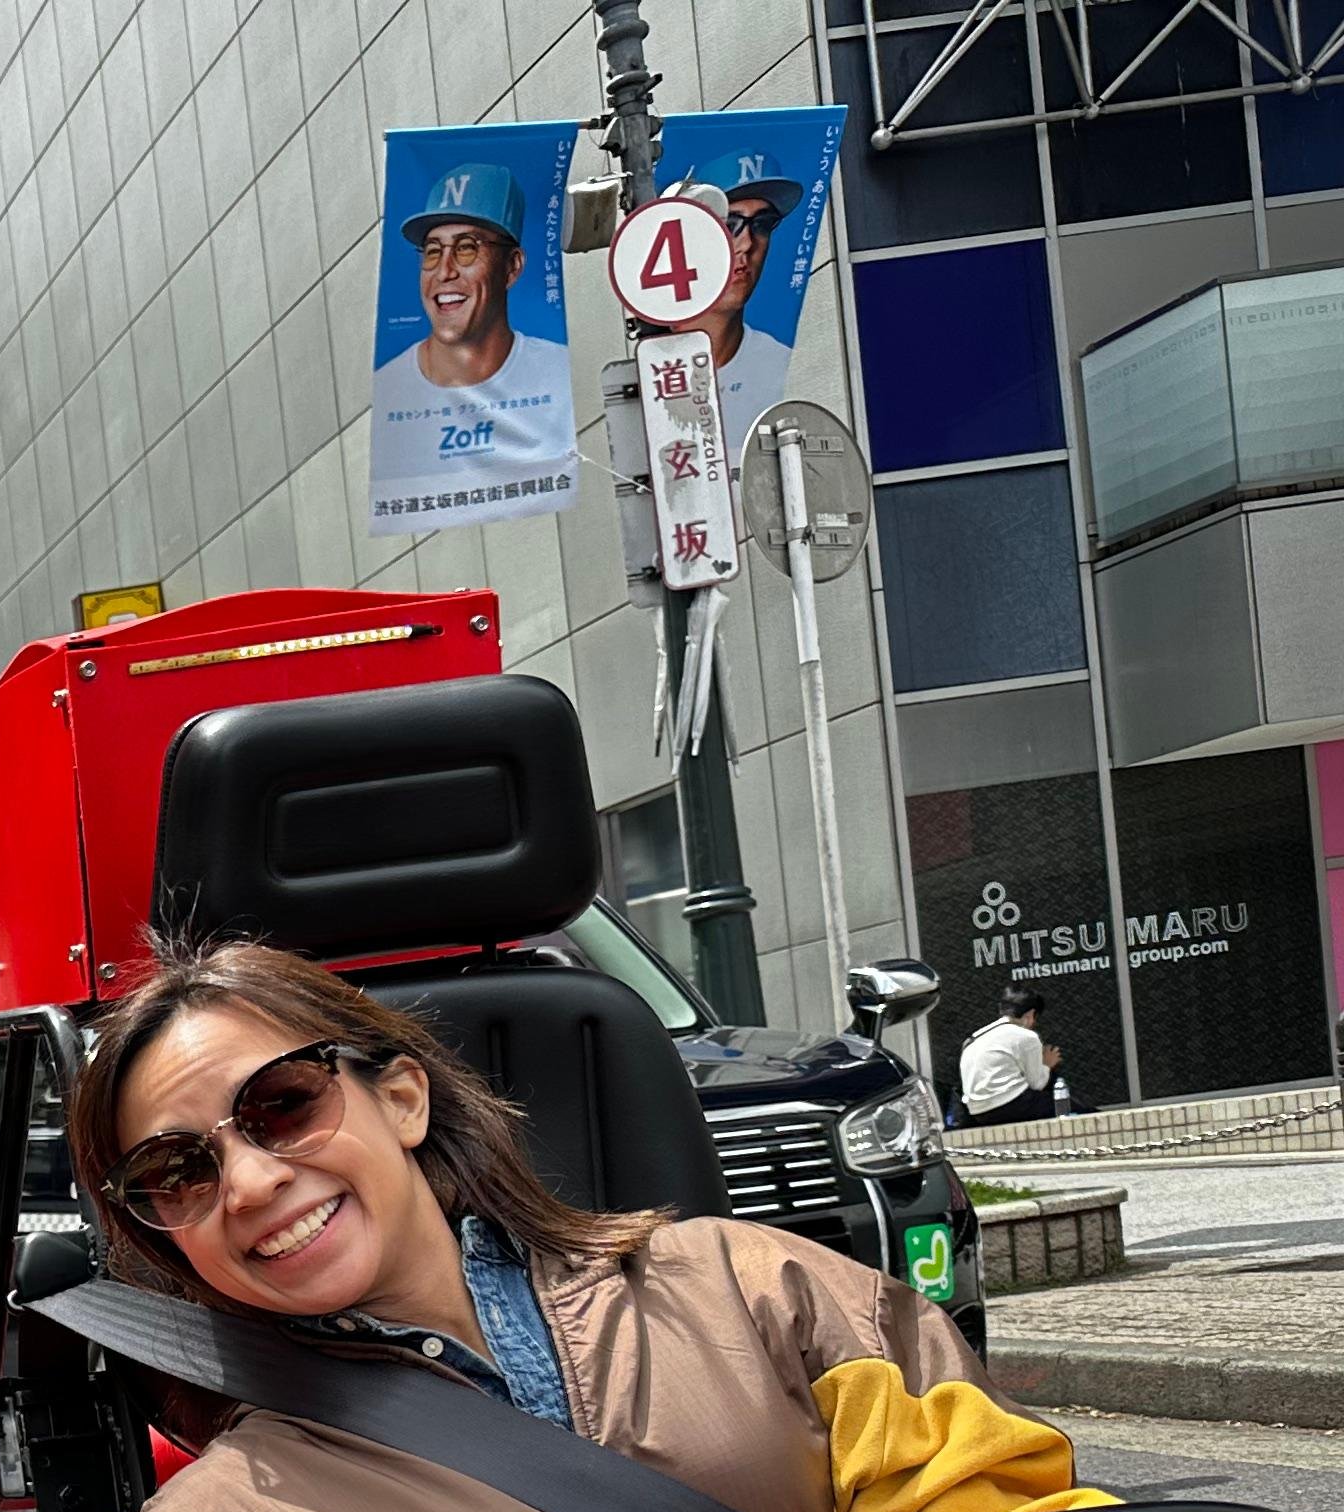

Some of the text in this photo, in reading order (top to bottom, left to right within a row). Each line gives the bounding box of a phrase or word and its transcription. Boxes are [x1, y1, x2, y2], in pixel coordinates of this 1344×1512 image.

[738, 155, 765, 184] N
[439, 174, 471, 209] N
[639, 218, 699, 303] 4
[439, 420, 494, 451] Zoff
[650, 358, 712, 563] 道玄坂
